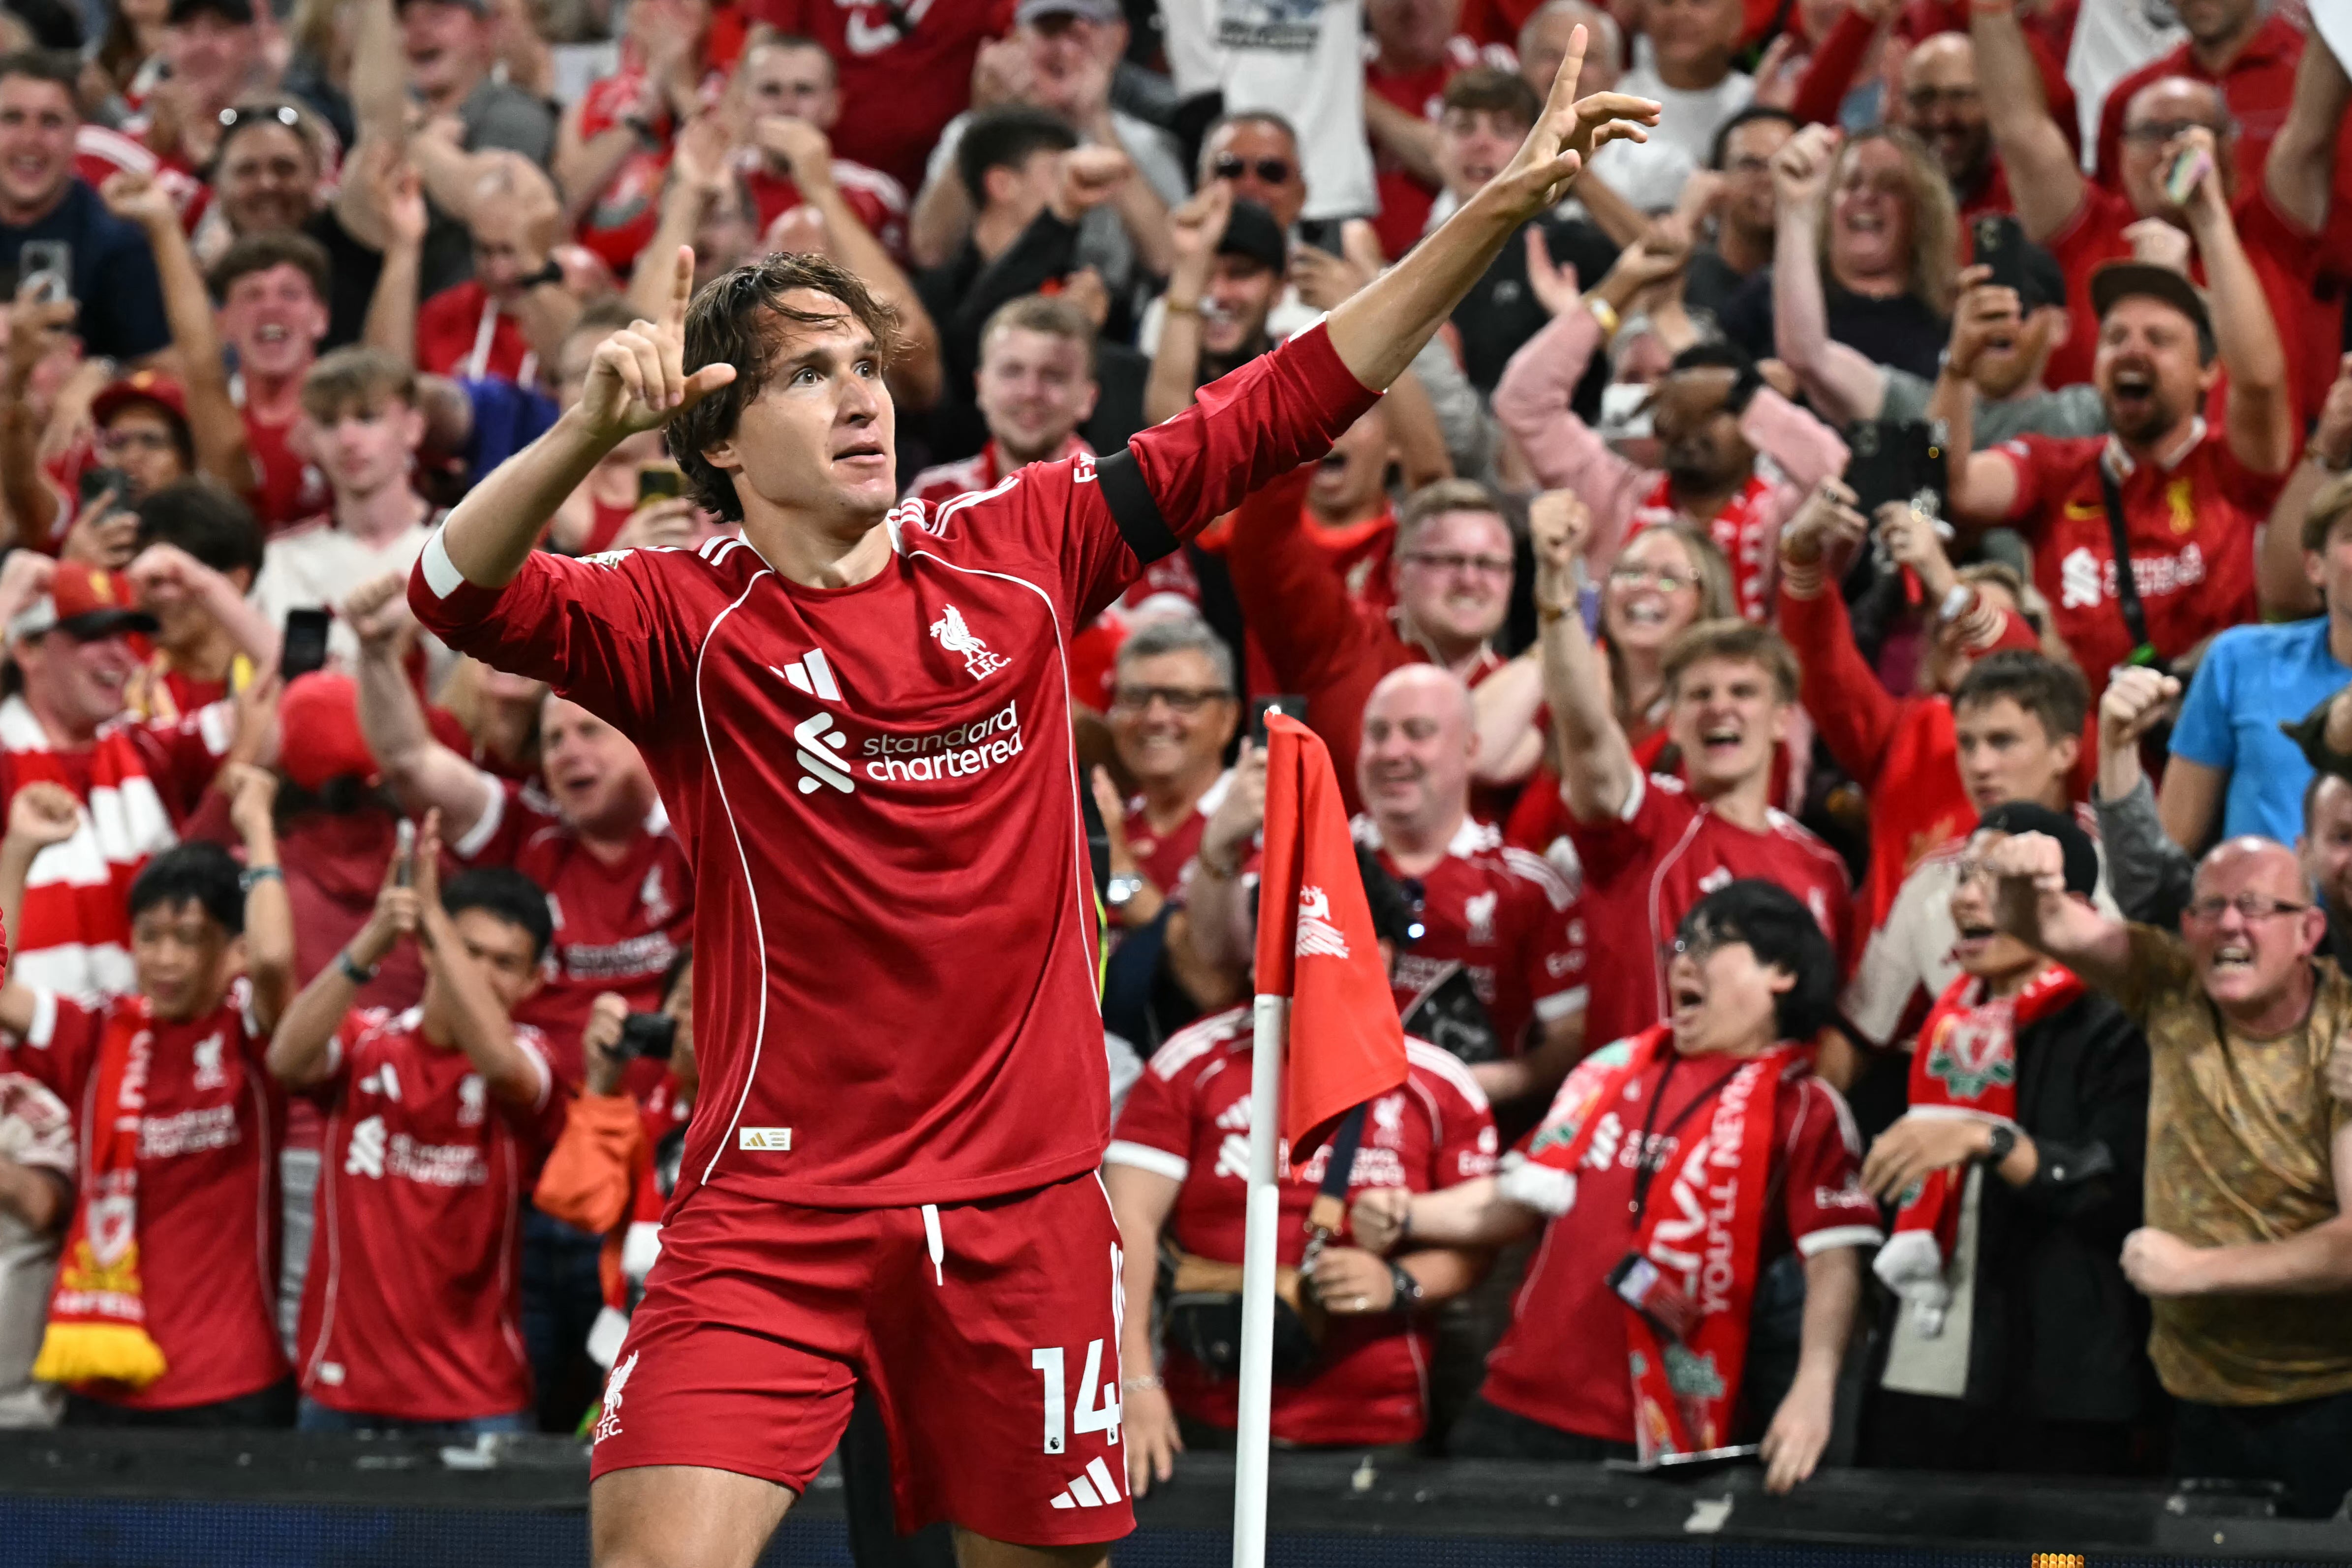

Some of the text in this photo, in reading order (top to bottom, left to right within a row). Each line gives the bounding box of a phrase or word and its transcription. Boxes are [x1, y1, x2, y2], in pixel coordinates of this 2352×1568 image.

[863, 699, 1018, 756] standard
[867, 725, 1023, 781] chartered
[1032, 1338, 1121, 1454] 14
